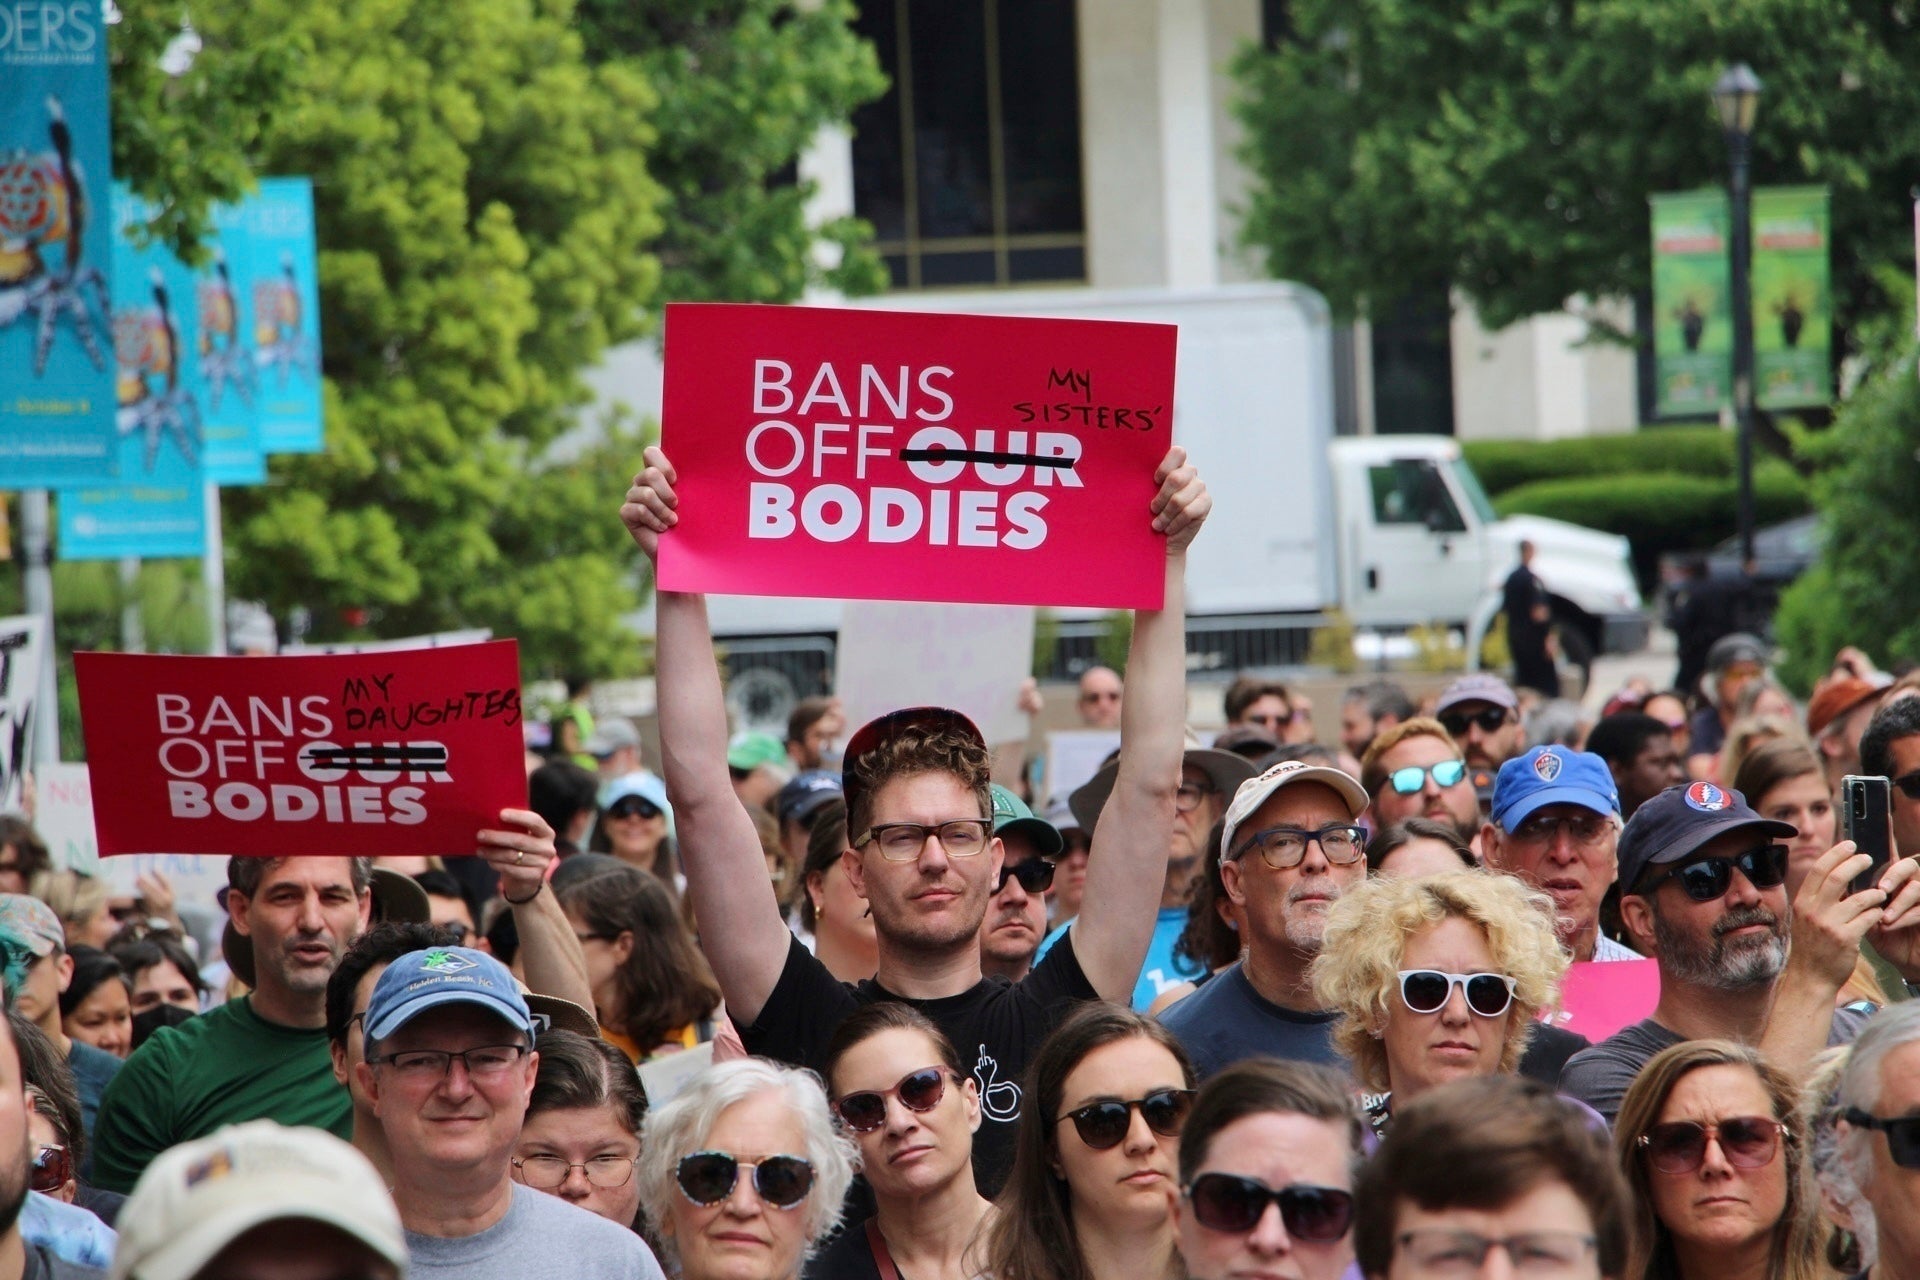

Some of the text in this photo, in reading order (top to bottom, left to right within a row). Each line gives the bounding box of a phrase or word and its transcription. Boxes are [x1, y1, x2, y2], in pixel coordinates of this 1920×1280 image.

[753, 359, 954, 422] BANS
[1013, 402, 1163, 432] SISTERS'
[745, 420, 1085, 488] OFF OUR
[749, 482, 1050, 550] BODIES
[342, 673, 394, 706] MY
[157, 694, 333, 738] BANS
[159, 738, 455, 783] OFF OUR
[168, 780, 428, 825] BODIES
